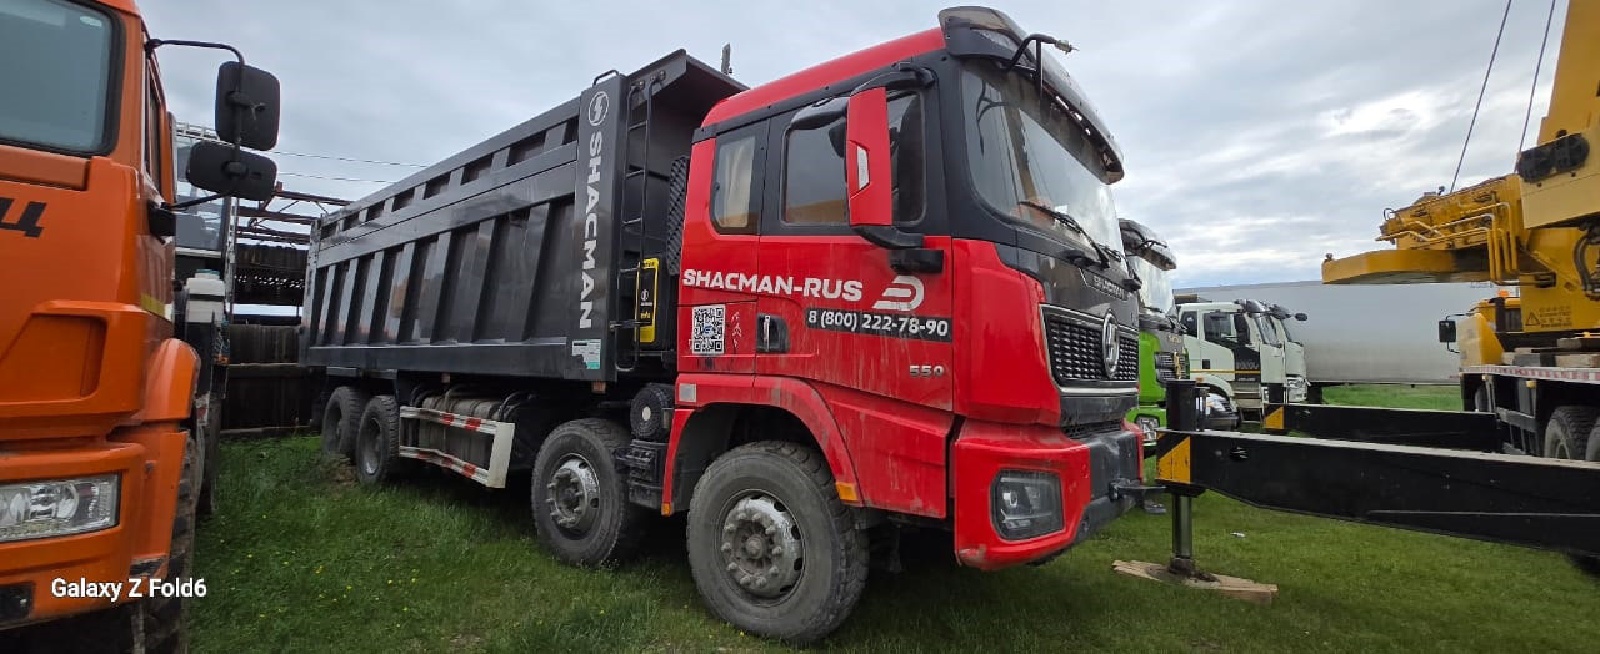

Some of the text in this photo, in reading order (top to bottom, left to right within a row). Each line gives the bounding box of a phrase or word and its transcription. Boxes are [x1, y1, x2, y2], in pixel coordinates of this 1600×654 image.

[580, 131, 602, 329] SHACMAN
[682, 268, 863, 302] SHACMAN-RUS
[808, 310, 948, 337] 8 (800) 222-78-90
[909, 365, 944, 378] 550
